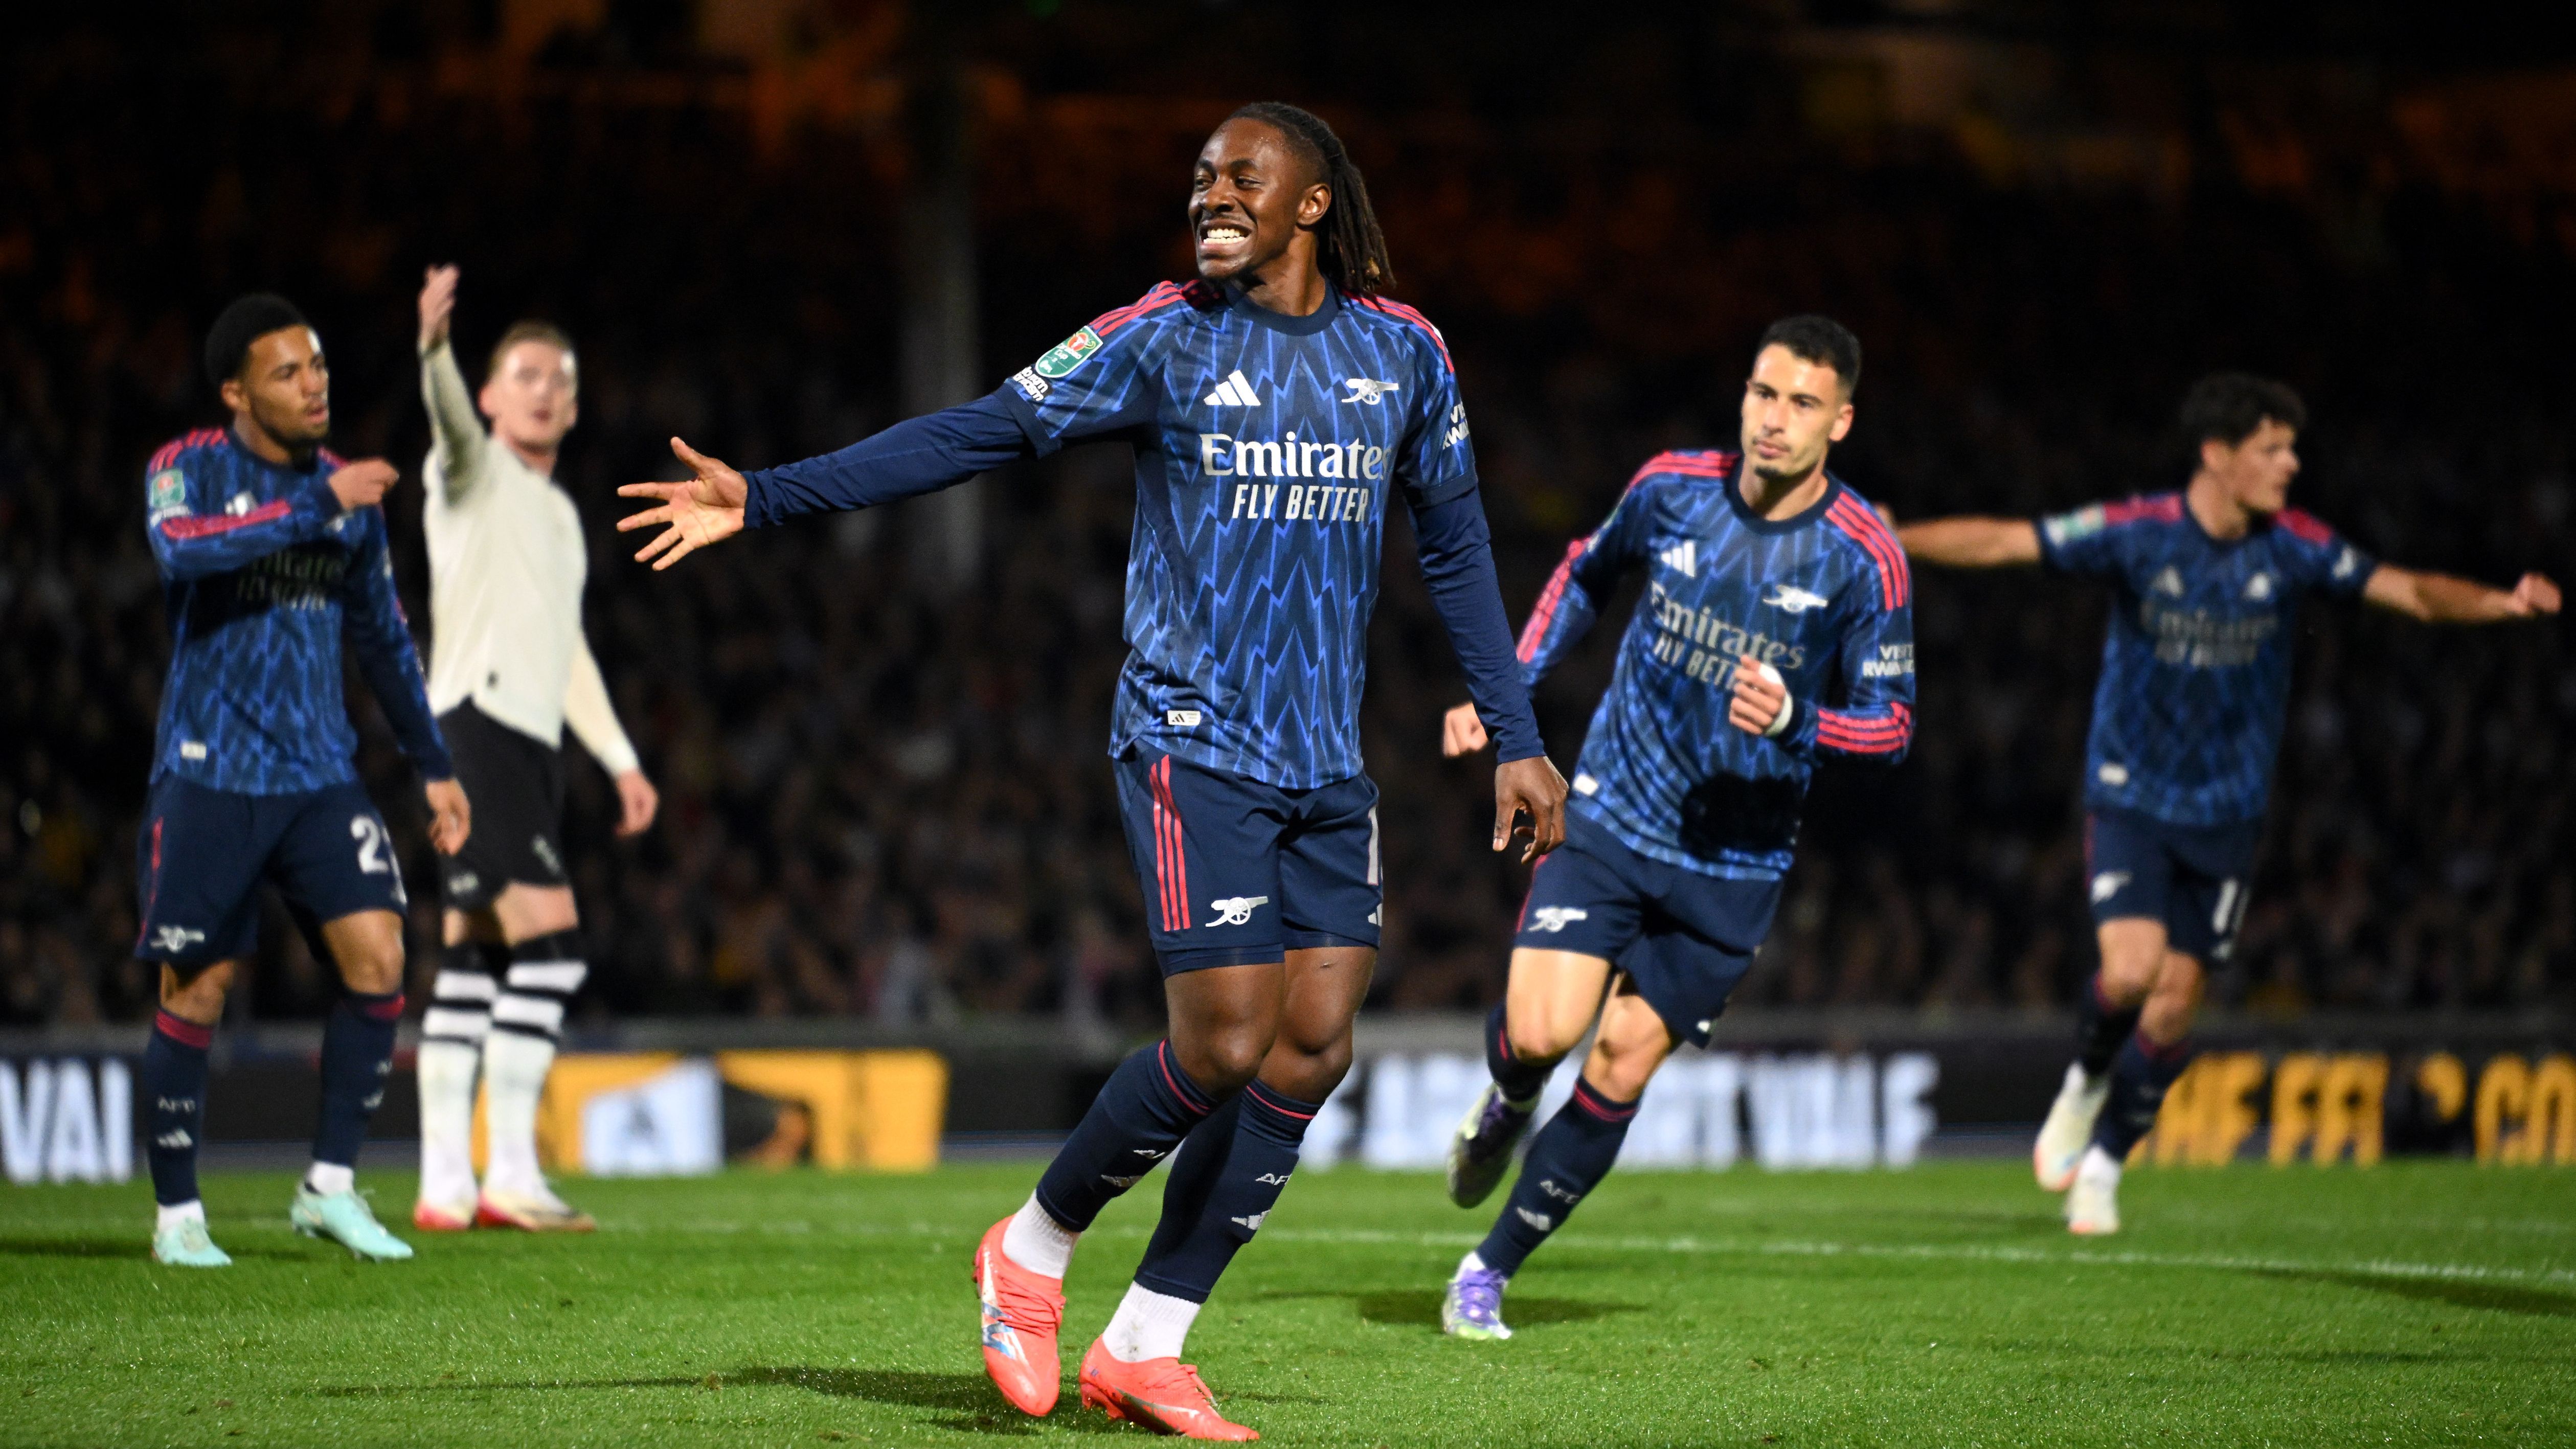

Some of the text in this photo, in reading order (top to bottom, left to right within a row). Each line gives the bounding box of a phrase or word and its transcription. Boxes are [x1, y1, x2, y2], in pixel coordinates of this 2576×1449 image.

[1232, 484, 1369, 522] FLY BETTER
[349, 814, 401, 878] 2
